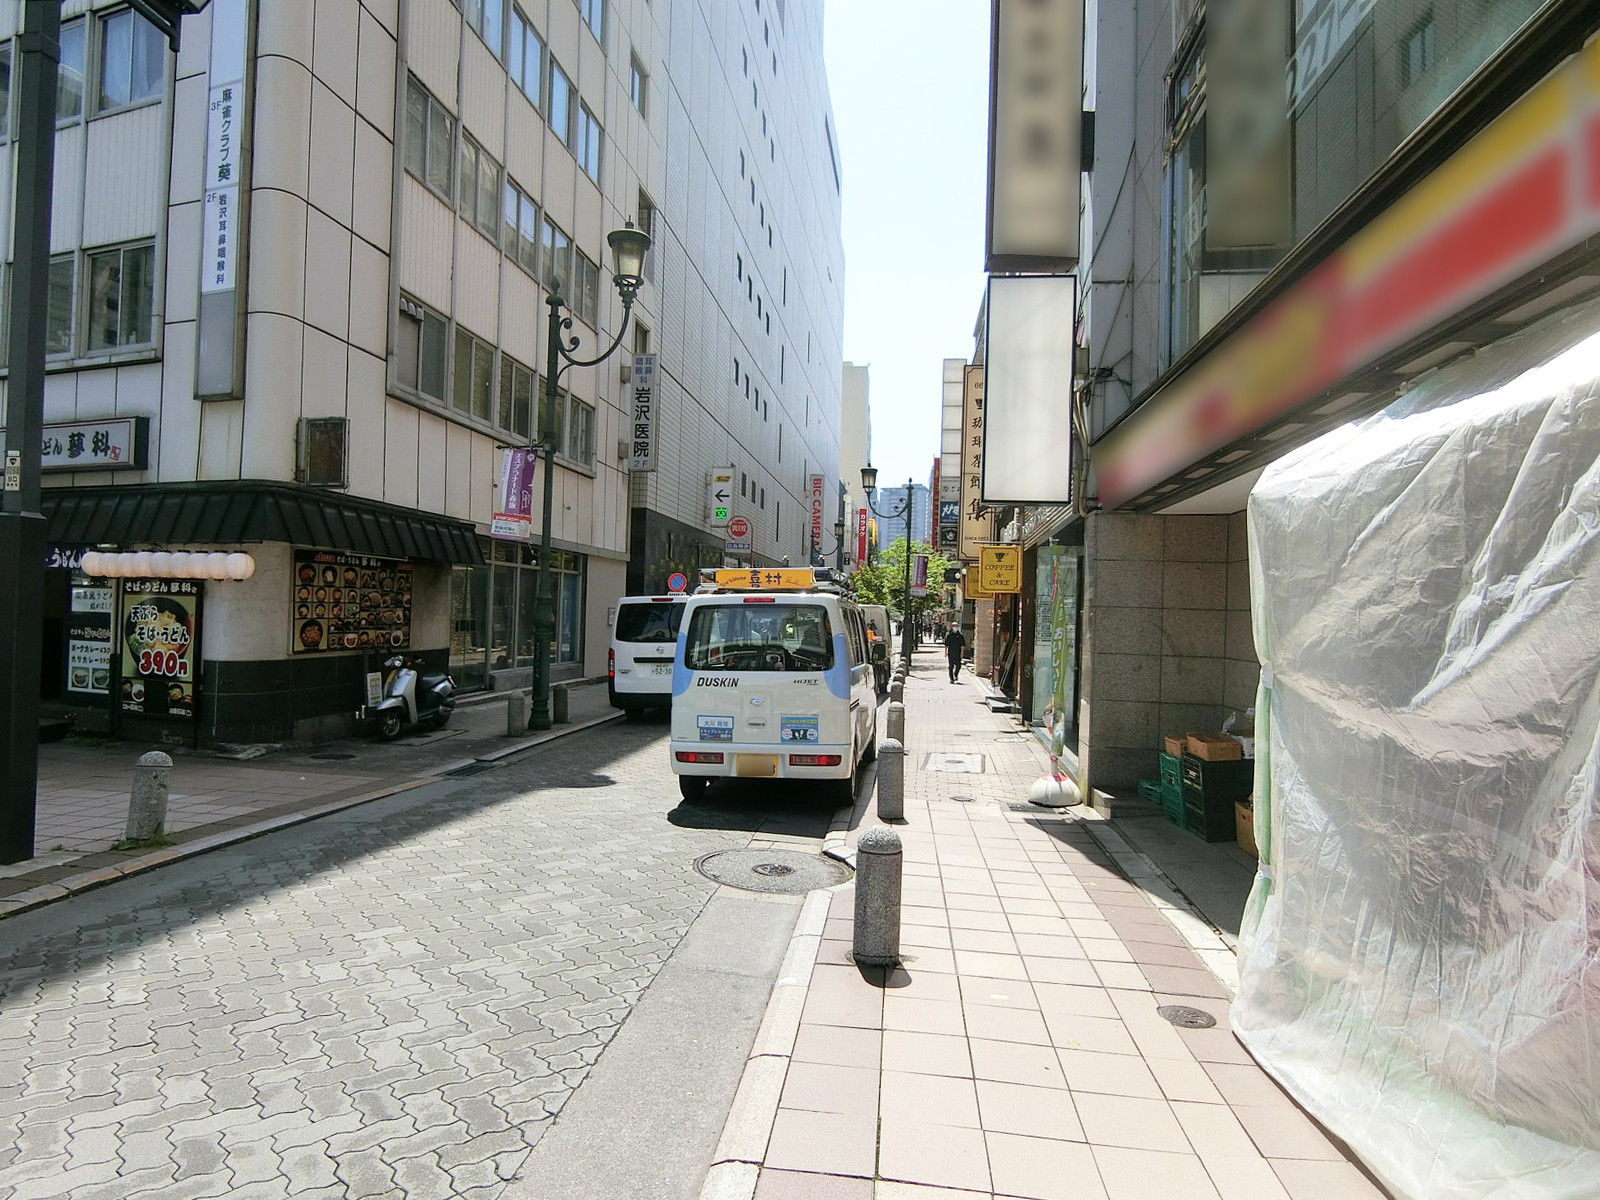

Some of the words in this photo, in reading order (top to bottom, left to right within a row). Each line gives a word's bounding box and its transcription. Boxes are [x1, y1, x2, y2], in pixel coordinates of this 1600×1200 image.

[211, 100, 222, 111] 3F
[217, 88, 233, 183] 麻雀クラブ葵
[206, 192, 217, 203] 2F
[215, 193, 228, 285] 岩沢耳鼻咽喉科
[633, 386, 651, 458] 岩沢医院
[633, 460, 649, 468] 2F
[812, 478, 822, 497] BIC
[811, 499, 821, 548] CAMERA
[859, 514, 867, 537] カラオケ
[125, 580, 169, 593] そば・うどん
[749, 569, 782, 588] 喜村
[131, 605, 158, 622] 天ぷら
[137, 625, 190, 643] そば・うどん
[140, 650, 188, 677] 390円
